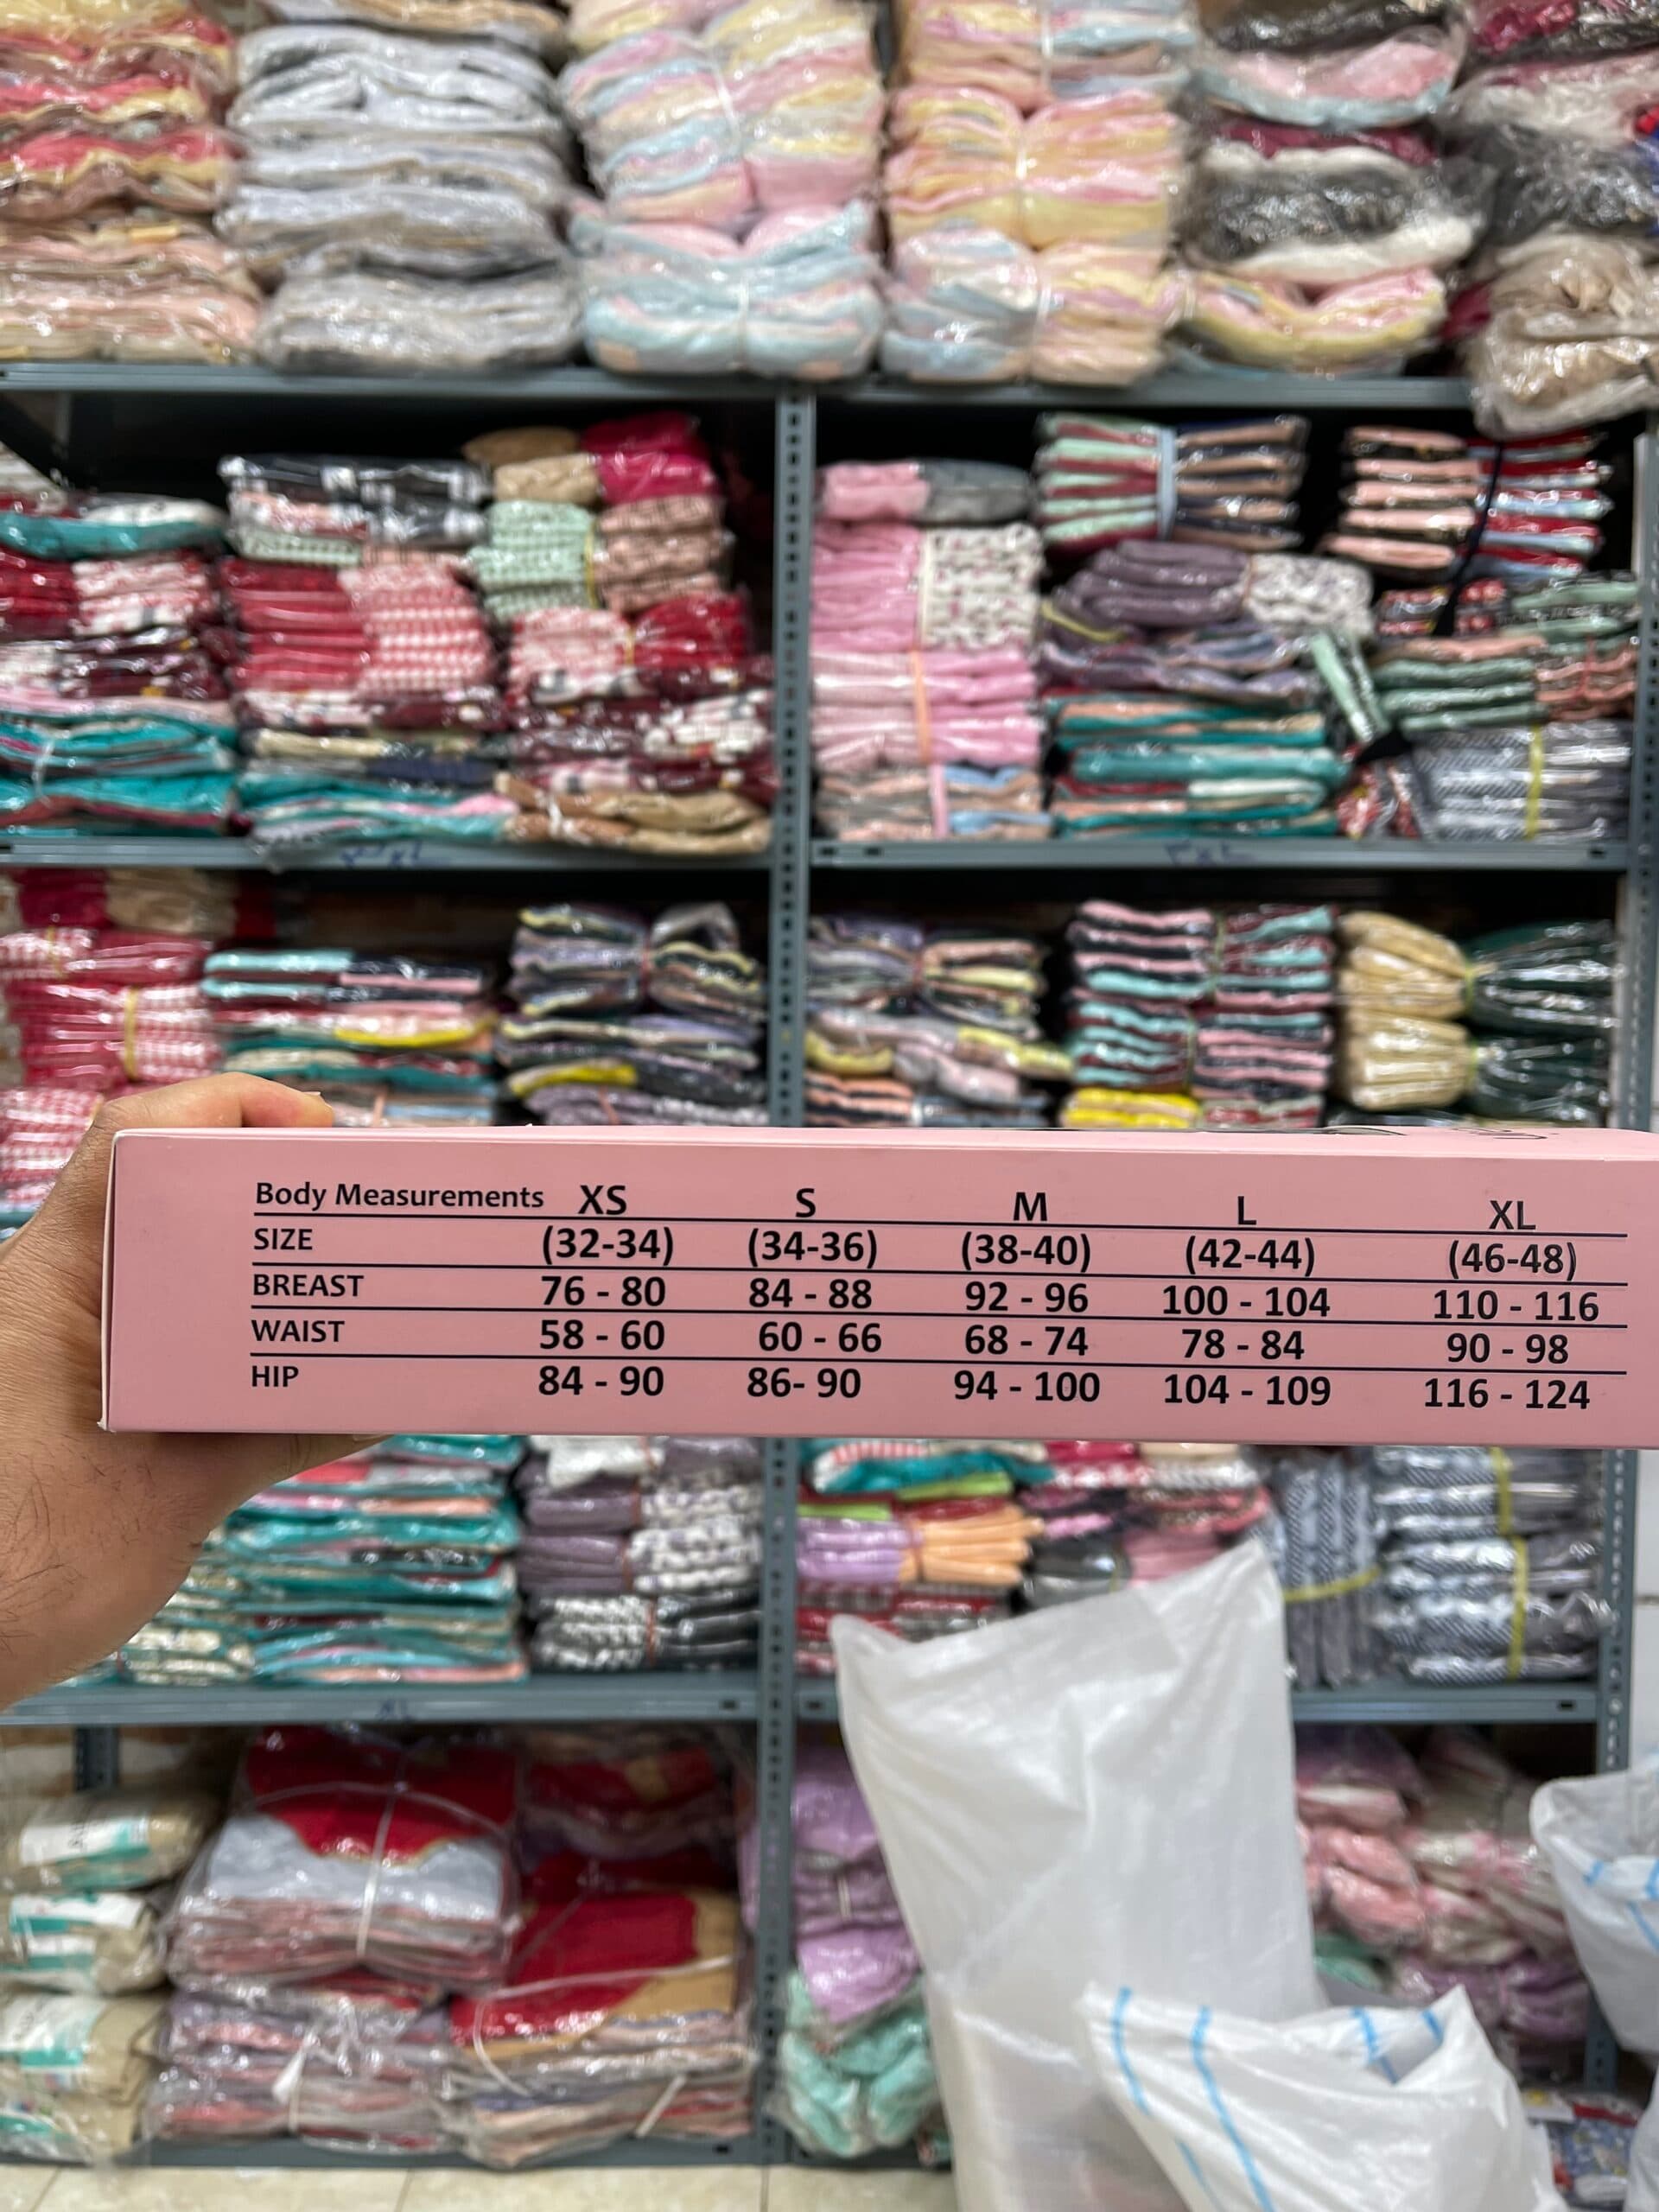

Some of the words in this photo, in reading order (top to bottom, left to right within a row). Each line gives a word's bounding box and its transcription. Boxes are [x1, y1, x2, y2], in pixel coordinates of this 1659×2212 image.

[256, 1181, 327, 1211] Body
[335, 1183, 544, 1208] Measurements
[577, 1185, 627, 1216] XS
[795, 1187, 817, 1218] S
[1013, 1192, 1048, 1222] M
[1237, 1195, 1257, 1226] L
[1488, 1199, 1536, 1230] XL
[253, 1228, 313, 1250] SIZE
[543, 1224, 674, 1266] (32-34)
[748, 1227, 878, 1268] (34-36)
[961, 1232, 1091, 1272] (38-40)
[1185, 1235, 1316, 1277] (42-44)
[1449, 1240, 1577, 1281] (46-48)
[253, 1274, 365, 1297] BREAST
[541, 1275, 585, 1306] 76
[620, 1275, 666, 1307] 80
[748, 1277, 793, 1308] 84
[828, 1278, 873, 1310] 88
[965, 1281, 1008, 1312] 92
[1045, 1282, 1089, 1313] 96
[1163, 1285, 1228, 1316] 100
[1265, 1287, 1331, 1318] 104
[1433, 1289, 1498, 1320] 110
[1535, 1291, 1599, 1322] 116
[251, 1319, 346, 1343] WAIST
[539, 1319, 584, 1350] 58
[620, 1319, 665, 1351] 60
[759, 1320, 803, 1352] 60
[838, 1322, 882, 1353] 66
[964, 1324, 1008, 1356] 68
[1045, 1325, 1089, 1357] 74
[1181, 1328, 1225, 1359] 78
[1261, 1329, 1305, 1360] 84
[1446, 1332, 1491, 1363] 90
[1525, 1333, 1569, 1364] 98
[251, 1365, 299, 1388] HIP
[538, 1365, 584, 1396] 84
[620, 1365, 664, 1396] 90
[954, 1370, 998, 1401] 94
[1034, 1371, 1101, 1402] 100
[1164, 1373, 1230, 1405] 104
[1266, 1375, 1332, 1407] 109
[1424, 1377, 1489, 1408] 116
[1525, 1379, 1591, 1410] 124
